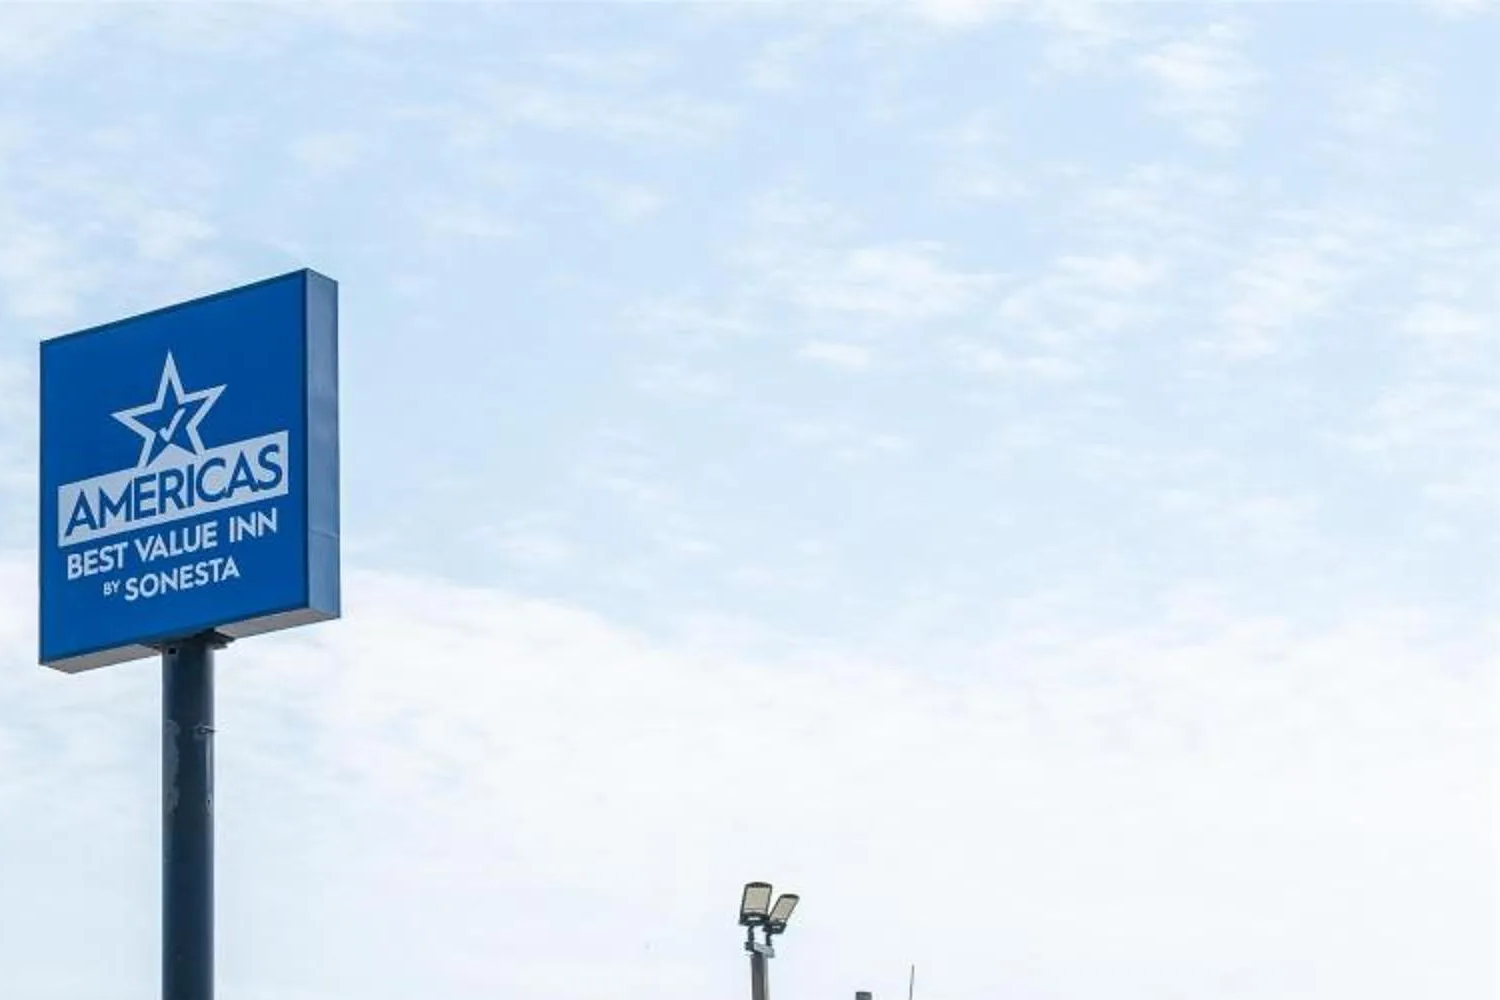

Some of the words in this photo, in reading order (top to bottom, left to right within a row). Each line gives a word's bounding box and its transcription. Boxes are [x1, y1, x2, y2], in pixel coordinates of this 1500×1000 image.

[65, 444, 283, 538] AMERICAS
[67, 543, 128, 580] BEST
[135, 522, 218, 562] VALUE
[229, 507, 277, 543] INN
[103, 580, 120, 597] BY
[124, 556, 240, 601] SONESTA
